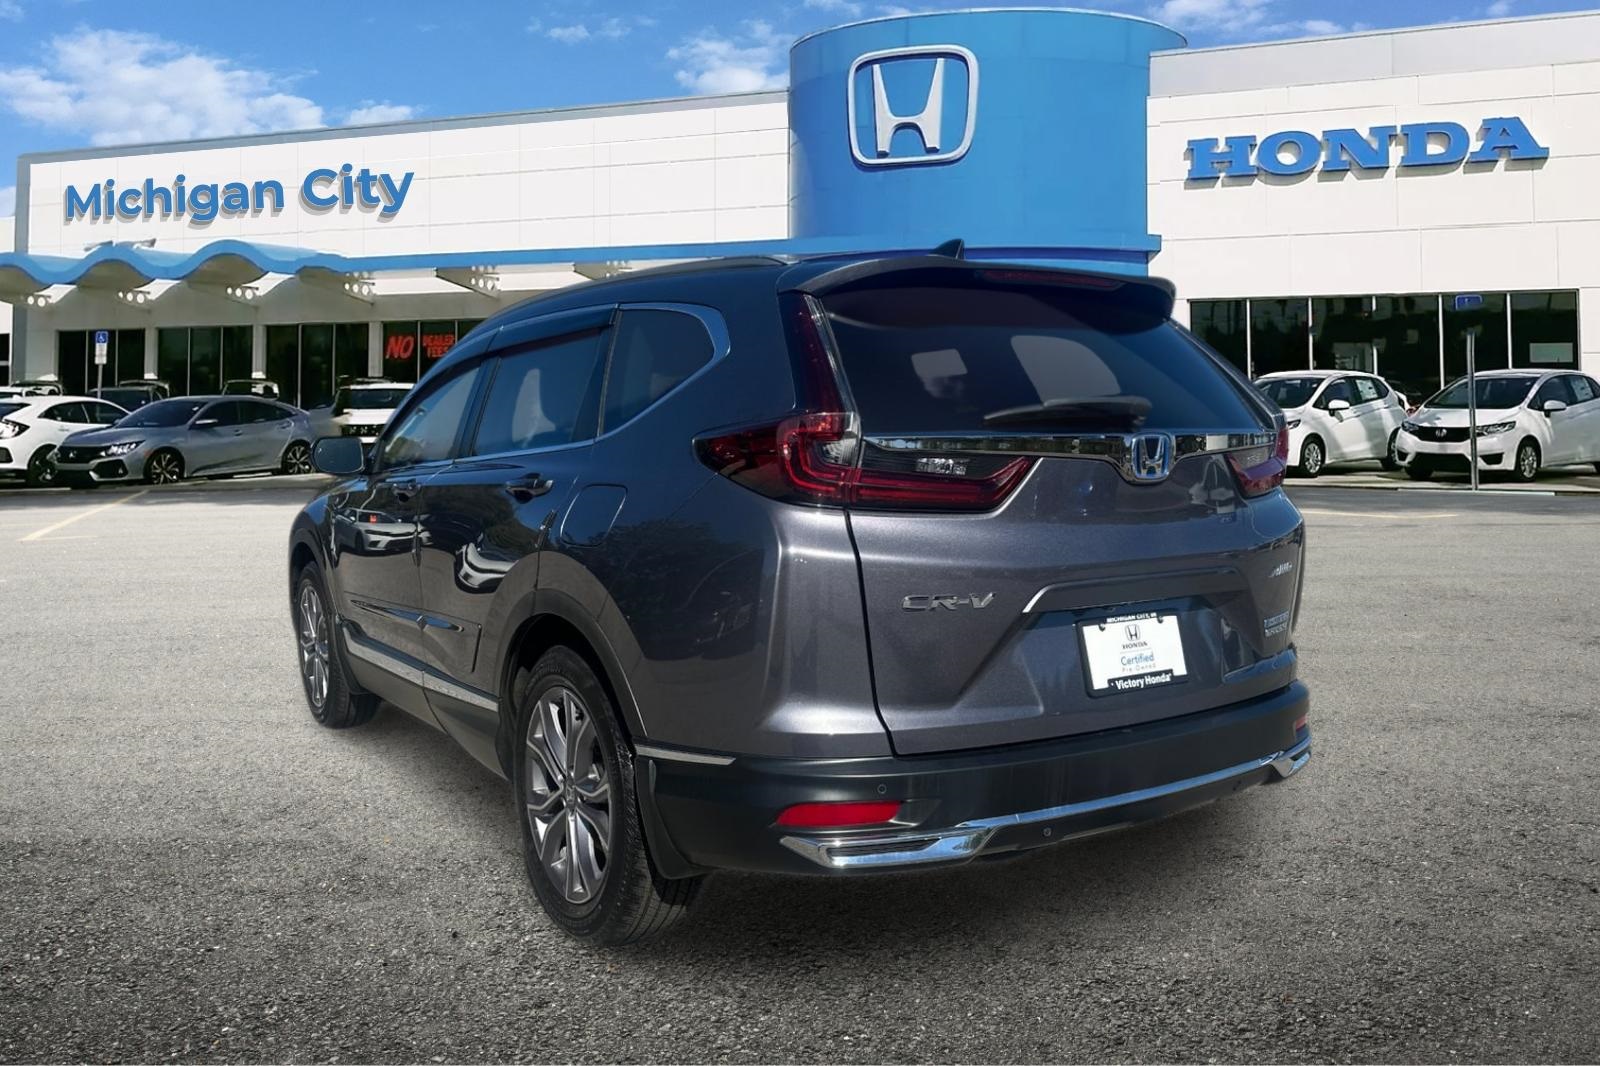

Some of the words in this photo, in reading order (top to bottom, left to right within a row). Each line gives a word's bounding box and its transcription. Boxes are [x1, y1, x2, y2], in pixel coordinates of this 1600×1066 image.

[1185, 116, 1550, 184] HONDA
[66, 174, 285, 224] Michigan
[300, 163, 415, 216] City
[384, 335, 415, 359] NO
[902, 592, 996, 611] CR-V
[1122, 641, 1148, 649] HONDA
[1121, 651, 1154, 666] Certified
[1115, 679, 1145, 690] Victory
[1144, 673, 1172, 685] Honda
